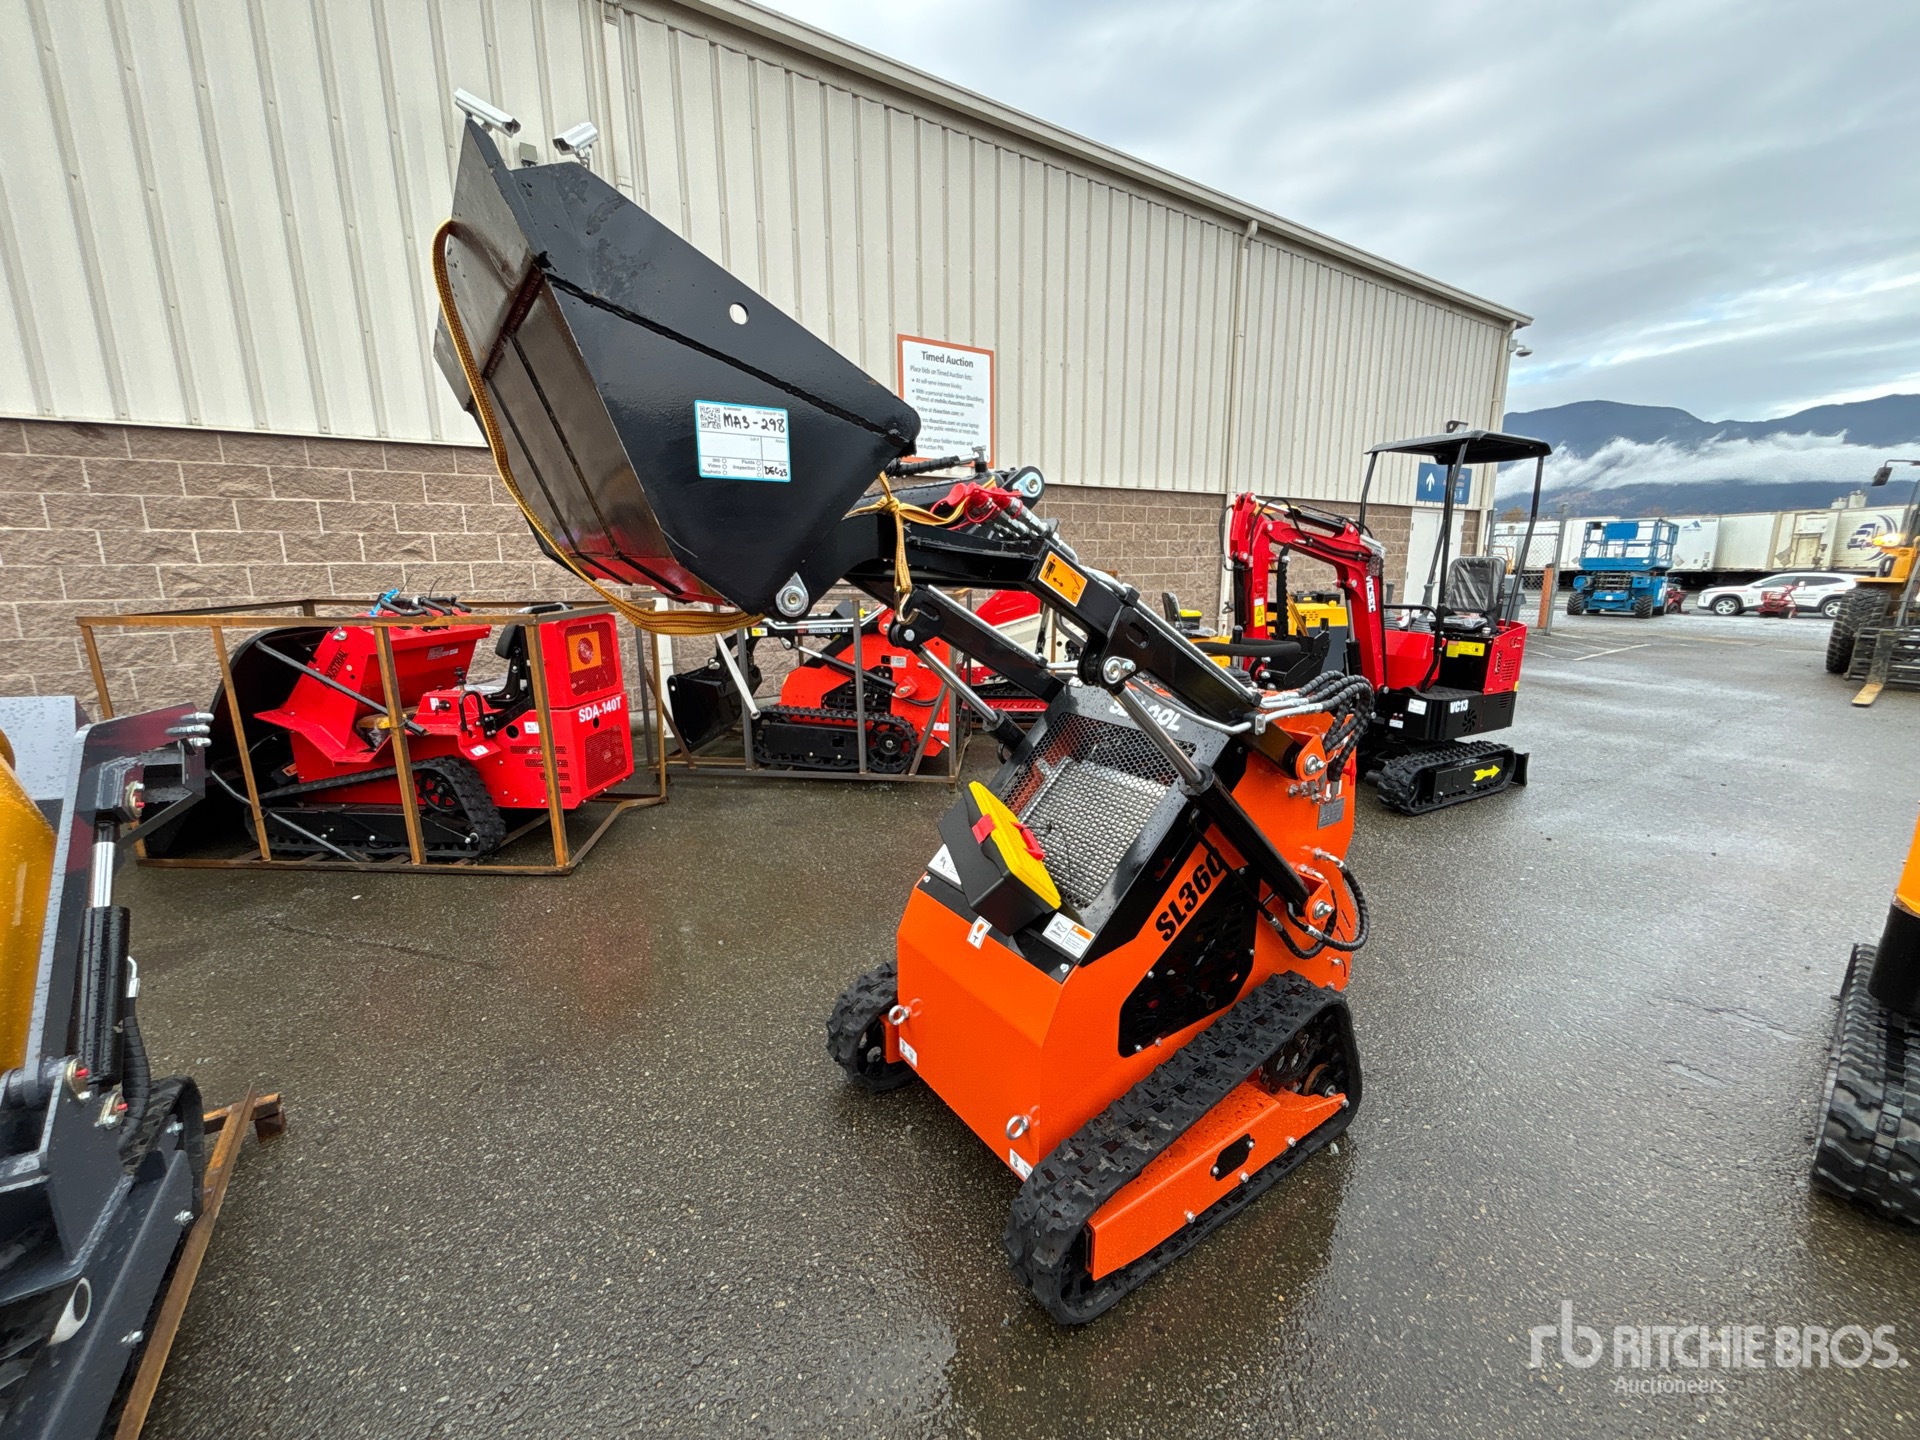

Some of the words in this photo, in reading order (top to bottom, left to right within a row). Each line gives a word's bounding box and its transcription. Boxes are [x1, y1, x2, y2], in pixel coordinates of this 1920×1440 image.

[921, 351, 945, 363] Timed
[946, 355, 974, 369] Auction
[723, 412, 785, 433] MA3-298
[578, 696, 622, 724] SDA-140T
[1450, 699, 1469, 714] VC13
[1155, 848, 1221, 942] SL360
